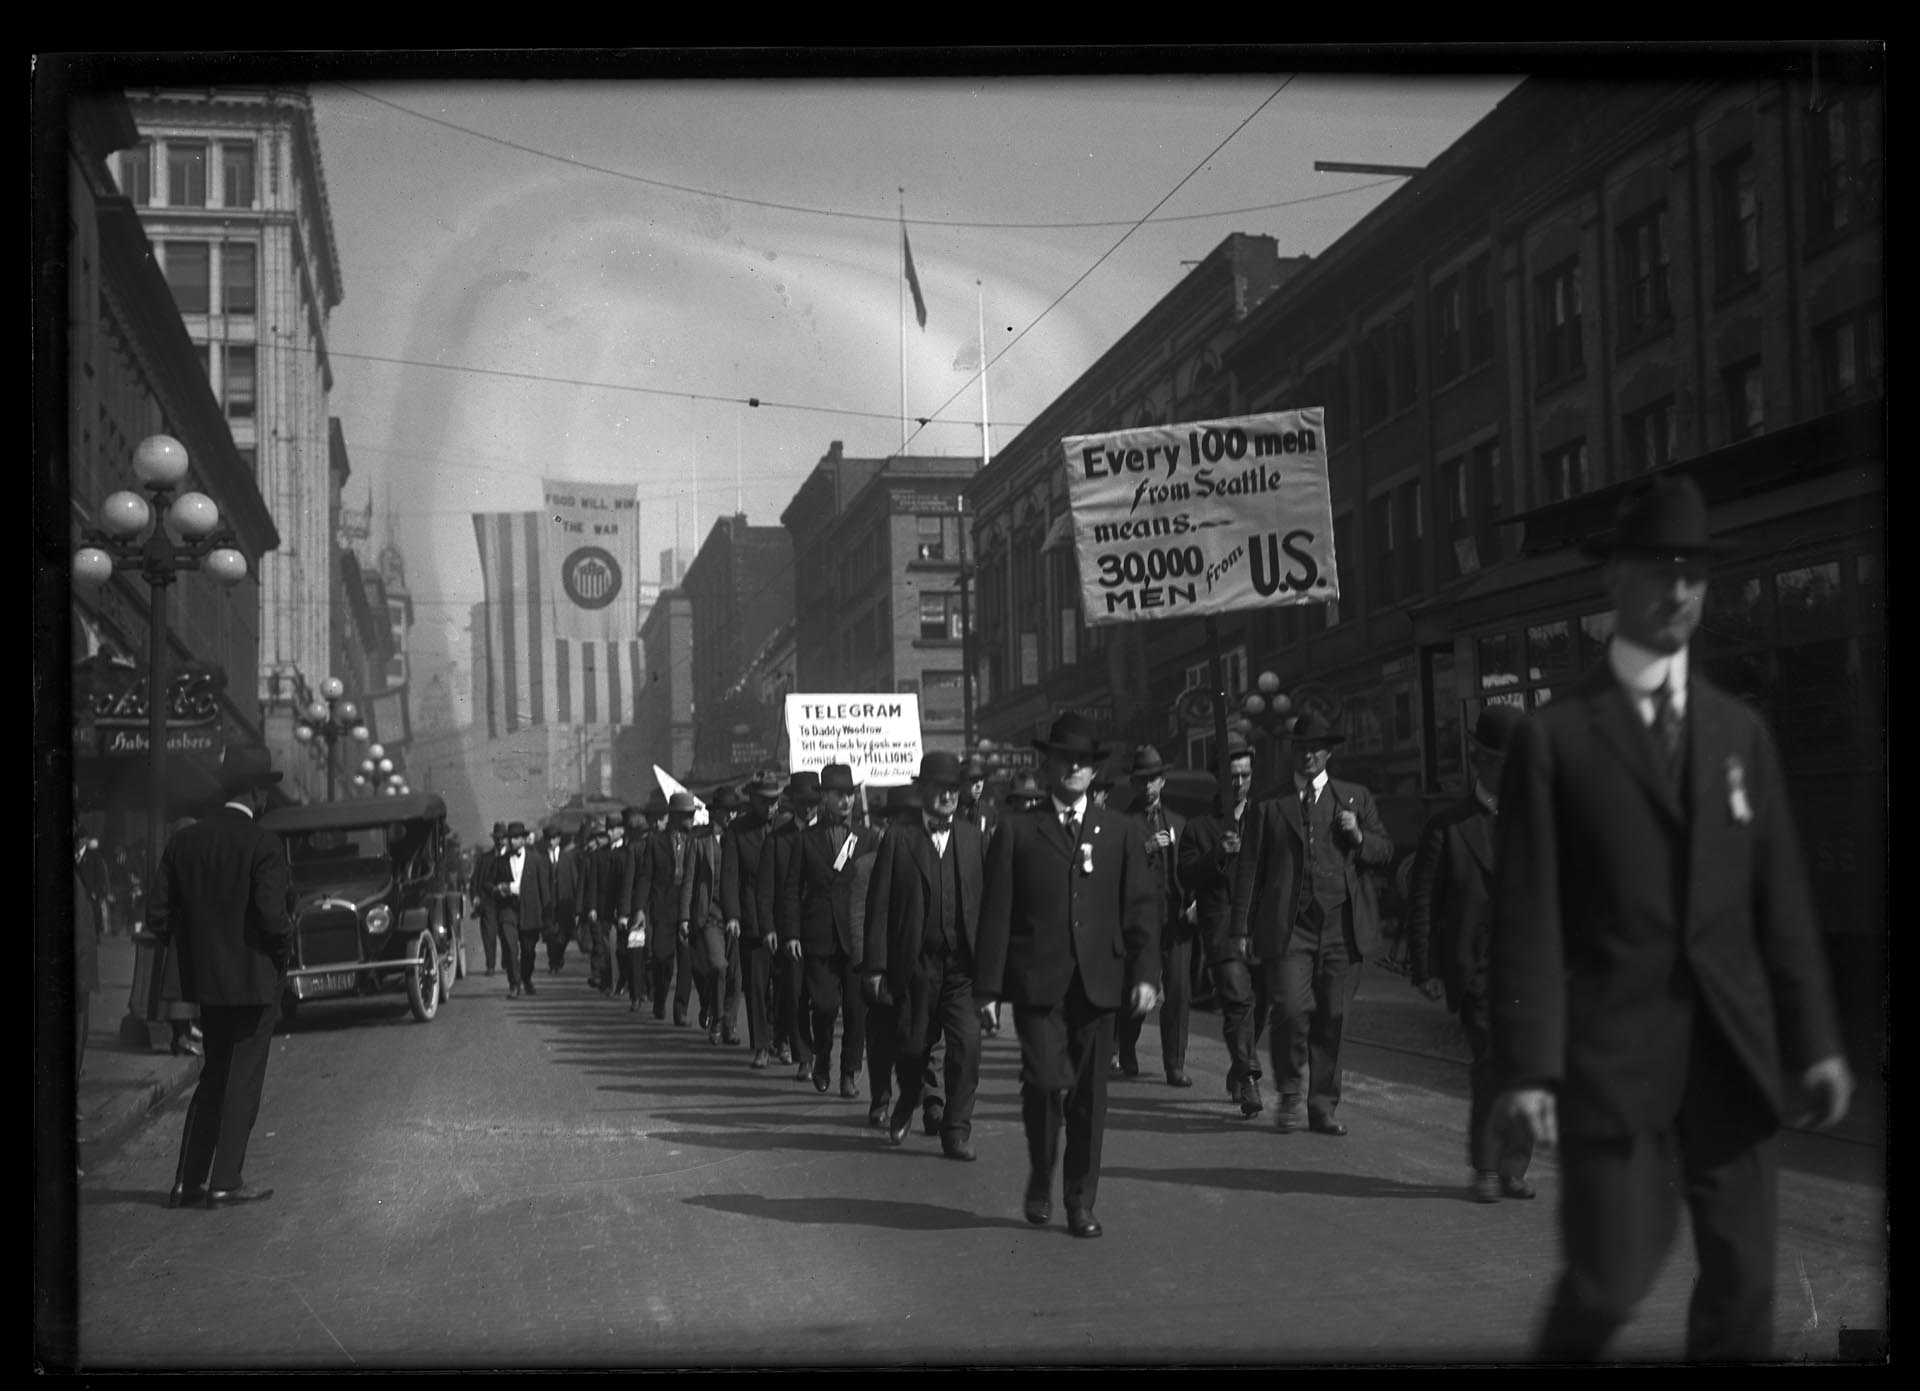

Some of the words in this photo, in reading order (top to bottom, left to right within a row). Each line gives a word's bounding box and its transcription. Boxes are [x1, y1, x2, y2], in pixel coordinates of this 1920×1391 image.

[1082, 444, 1180, 479] Every
[1189, 428, 1248, 467] 100
[1253, 428, 1316, 458] men
[1130, 478, 1191, 515] from
[1194, 465, 1282, 497] Seattle
[563, 521, 584, 534] THE
[593, 523, 618, 535] WAR
[1097, 545, 1204, 589] 30,000
[1206, 545, 1245, 593] from
[1249, 529, 1327, 597] U.S.
[1105, 583, 1197, 613] MEN
[801, 704, 901, 719] TELEGRAM
[800, 725, 810, 736] To
[812, 724, 840, 740] Daddy
[842, 723, 882, 736] Woodrow
[801, 740, 816, 751] Tell
[856, 737, 867, 752] by
[850, 752, 862, 767] by
